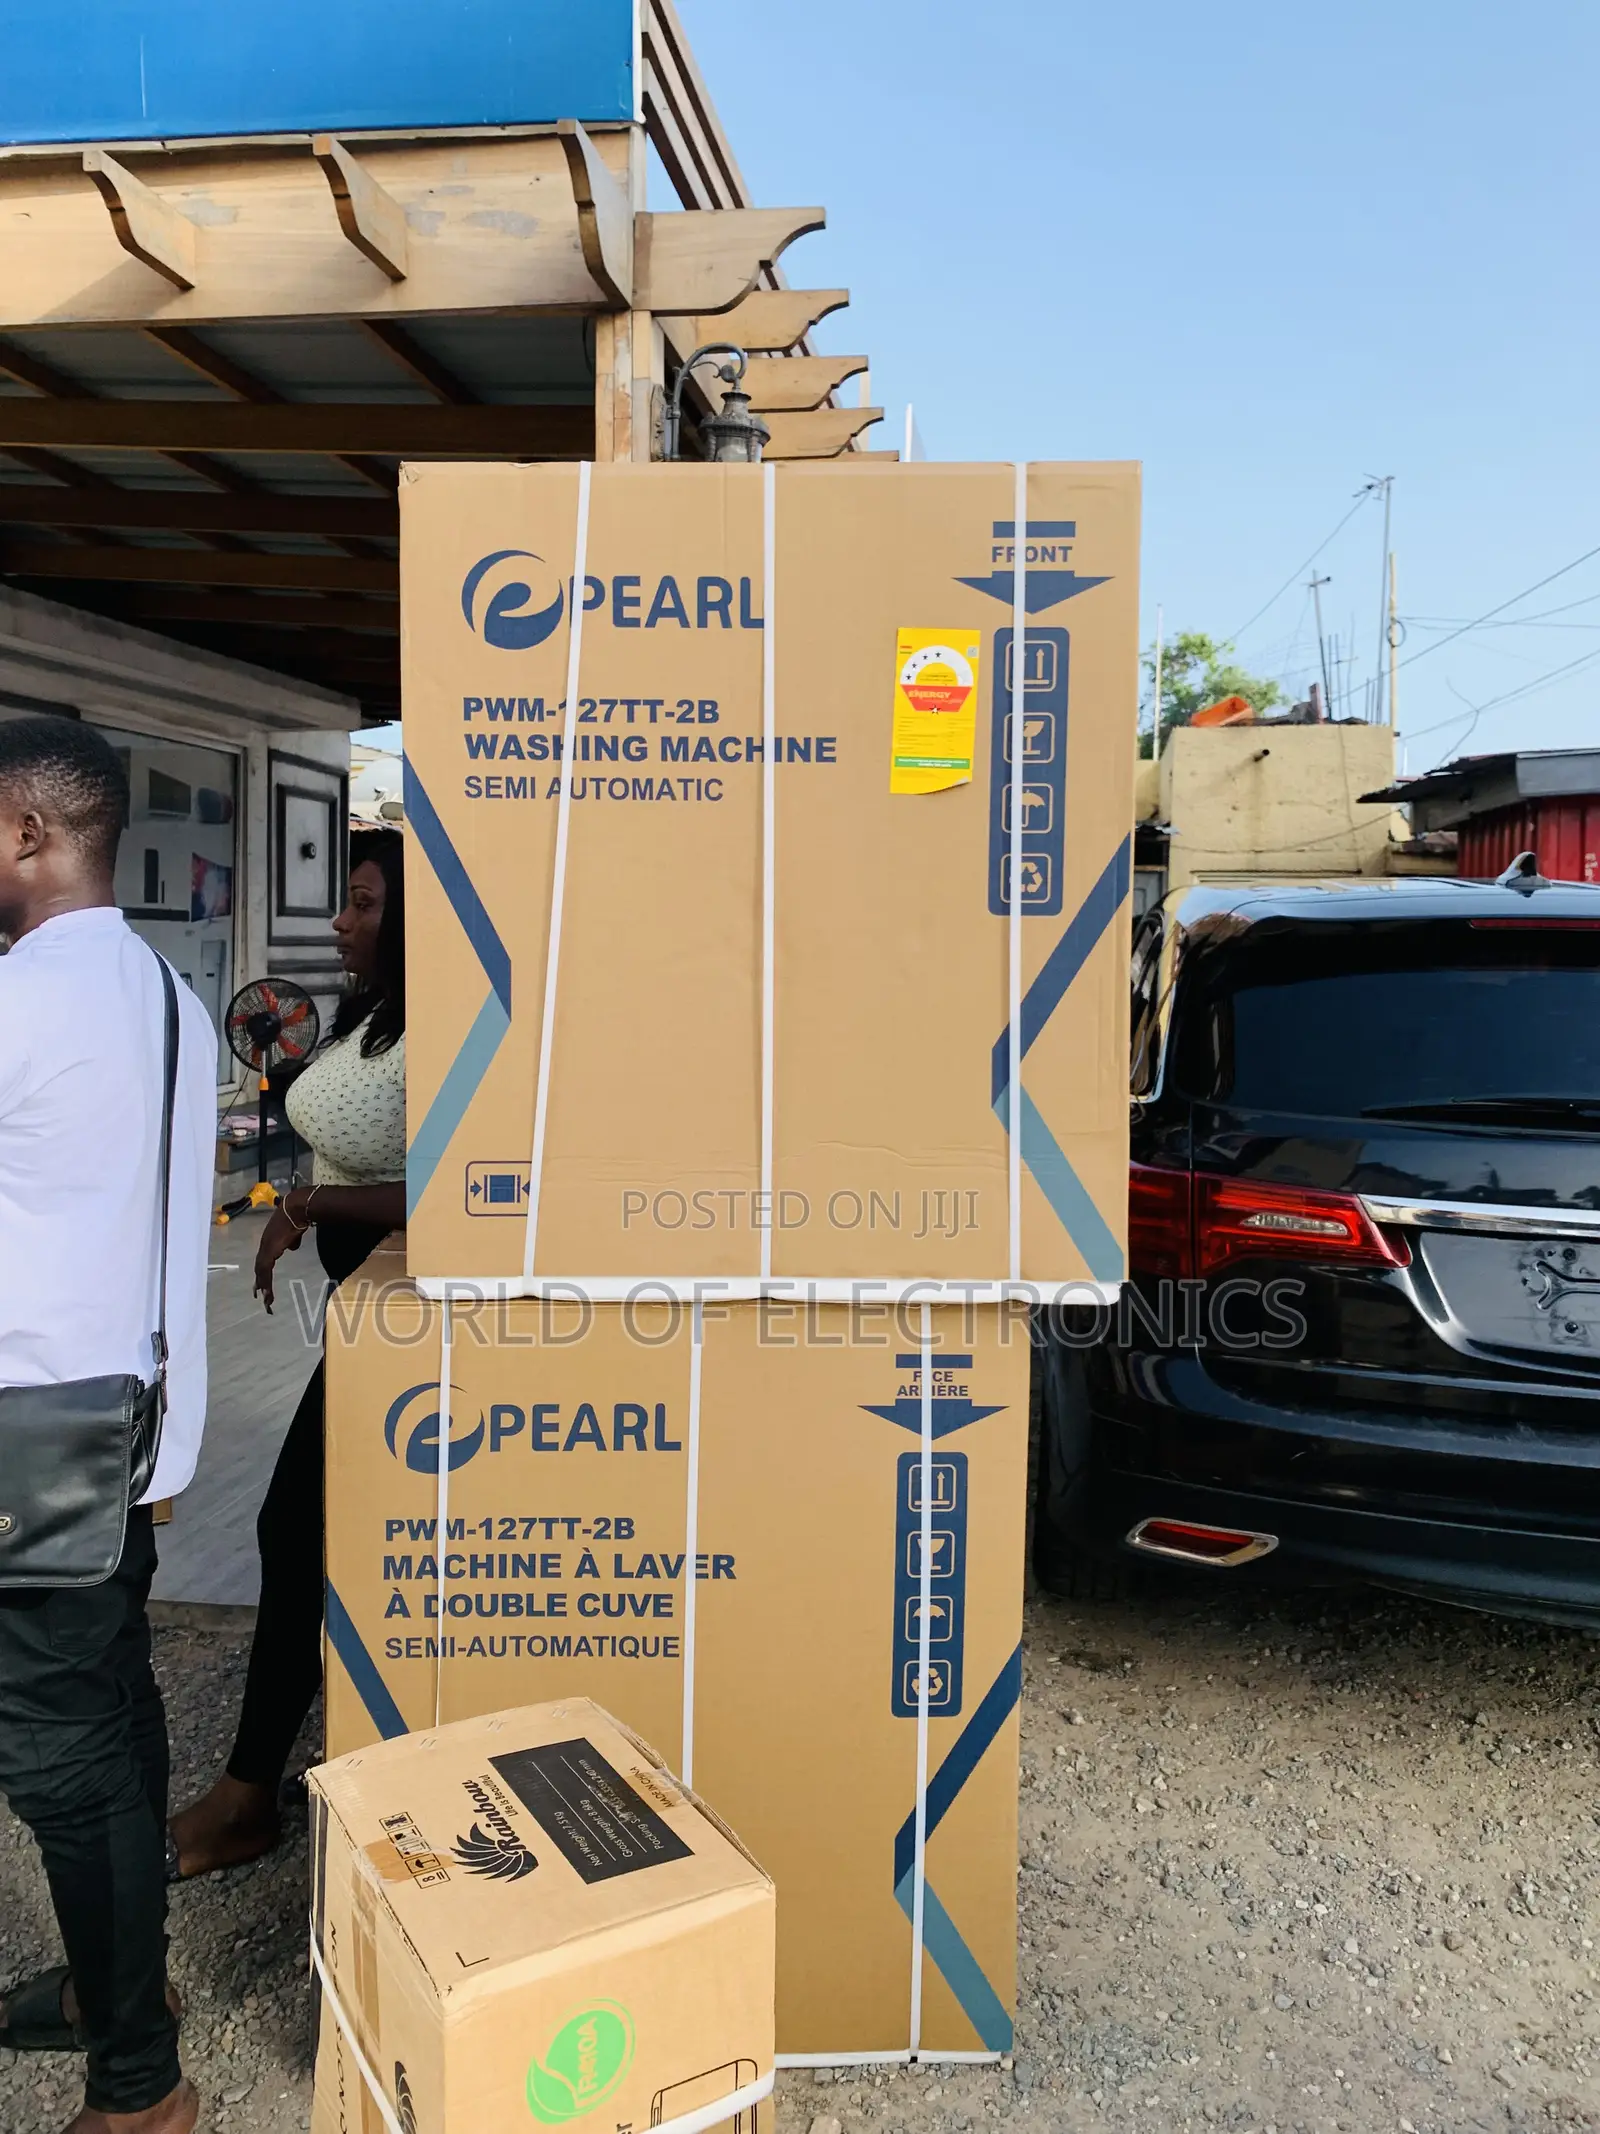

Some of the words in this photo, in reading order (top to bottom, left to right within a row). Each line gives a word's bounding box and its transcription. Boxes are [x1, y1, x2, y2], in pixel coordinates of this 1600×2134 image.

[991, 545, 1073, 563] FRONT
[569, 575, 766, 629] PEARL
[464, 733, 649, 762] WASHING
[660, 735, 838, 764] MACHINE
[464, 775, 537, 800] SEMI
[546, 777, 724, 802] AUTOMATIC
[912, 1370, 954, 1383] FCE
[896, 1382, 969, 1397] ARIÈRE
[489, 1402, 683, 1453] PEARL
[384, 1517, 636, 1541] PWM-127TT-2B
[383, 1553, 562, 1580] MACHINE
[574, 1547, 601, 1579] À
[613, 1553, 737, 1580] LAVER
[384, 1587, 411, 1619] À
[424, 1593, 568, 1619] DOUBLE
[577, 1593, 674, 1619] CUVE
[384, 1635, 681, 1660] SEMI-AUTOMATIQUE
[628, 1765, 652, 1785] CHINA
[502, 1803, 519, 1817] Life
[650, 1788, 674, 1809] MADE
[462, 1779, 528, 1857] Rainbow
[611, 1838, 634, 1858] Gross
[634, 1822, 666, 1850] Packing
[586, 1852, 604, 1867] Net
